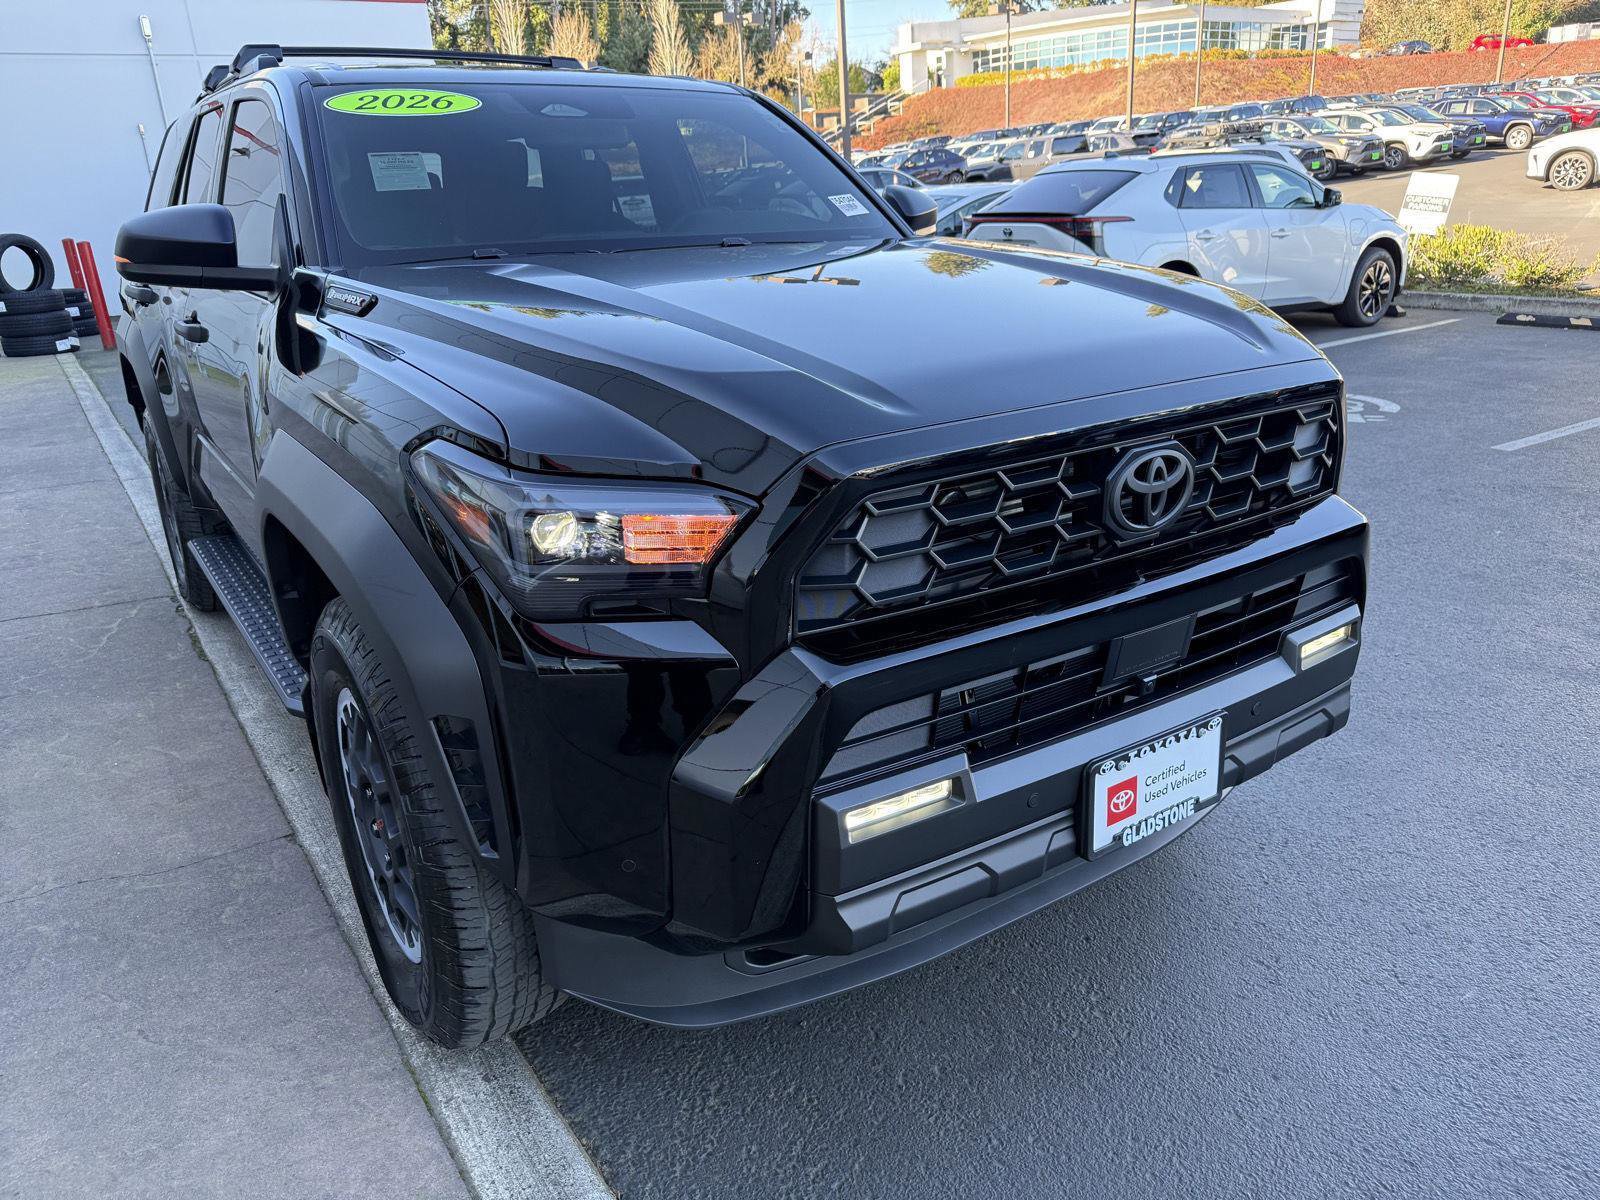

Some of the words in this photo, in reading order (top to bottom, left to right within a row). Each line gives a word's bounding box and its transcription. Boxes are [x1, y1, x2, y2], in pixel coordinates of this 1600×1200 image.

[354, 94, 454, 110] 2026
[1405, 194, 1450, 206] CUSTOMER
[1128, 727, 1197, 761] TOYOTA
[1144, 783, 1169, 803] Used
[1170, 768, 1207, 791] Vehicles
[1145, 760, 1186, 787] Certified
[1122, 798, 1195, 847] GLADSTONE
